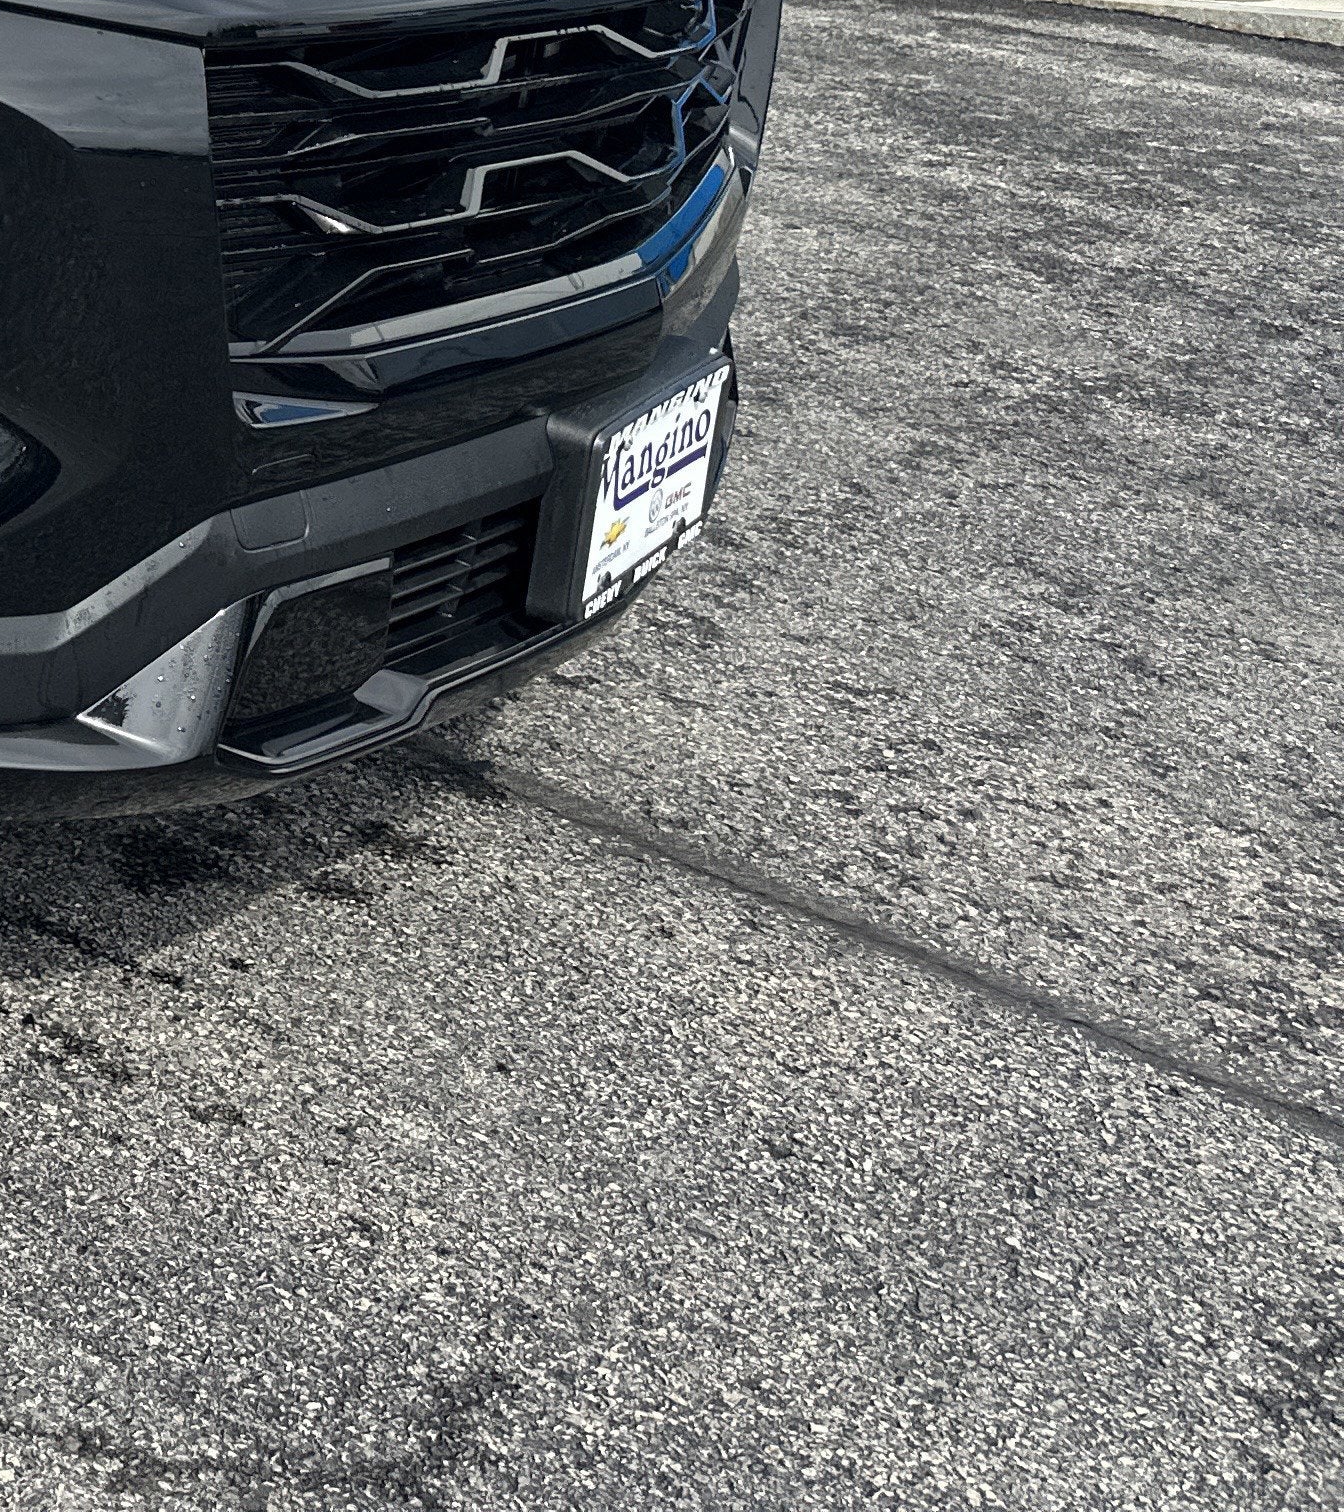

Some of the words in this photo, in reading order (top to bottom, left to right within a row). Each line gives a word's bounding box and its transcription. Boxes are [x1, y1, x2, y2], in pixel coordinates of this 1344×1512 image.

[609, 364, 730, 451] MANGINO
[600, 408, 711, 511] Mangino
[664, 481, 692, 509] GMC
[584, 580, 622, 619] CHEVY
[633, 545, 668, 583] BUICK
[677, 520, 704, 550] GMC
